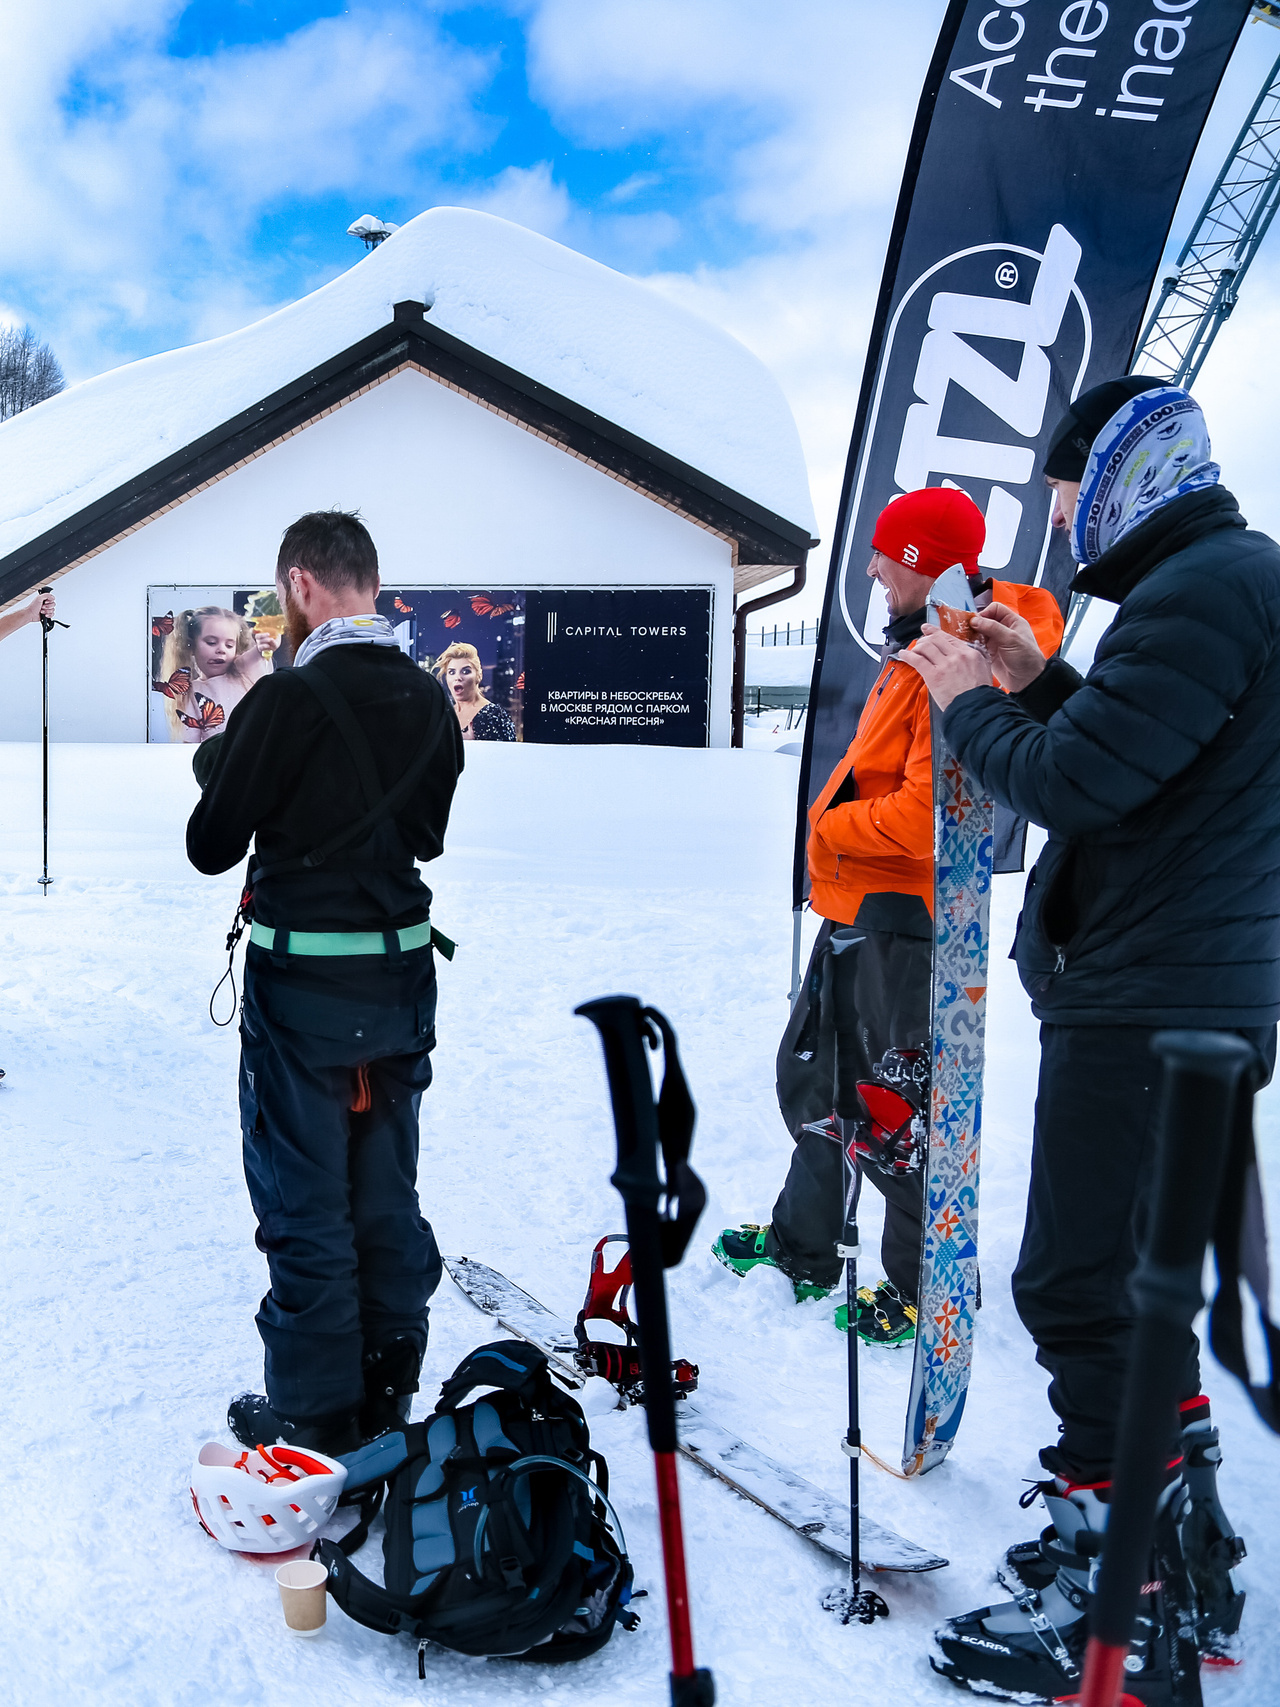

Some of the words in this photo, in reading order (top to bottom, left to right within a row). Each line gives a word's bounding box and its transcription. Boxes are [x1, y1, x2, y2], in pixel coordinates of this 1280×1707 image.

[948, 0, 1032, 110] Ac
[1023, 0, 1110, 113] the
[1141, 405, 1174, 430] 100
[1106, 451, 1124, 476] 50
[1088, 503, 1101, 526] 30
[565, 626, 622, 636] CAPITAL
[630, 626, 687, 636] TOWERS
[548, 691, 599, 700] КВАРТИРЫ
[601, 691, 608, 700] В
[610, 691, 684, 701] НЕБОСКРЕБАХ
[540, 703, 547, 713] В
[549, 703, 593, 713] МОСКВЕ
[595, 704, 633, 715] РЯДОМ
[635, 704, 644, 714] С
[646, 704, 690, 714] ПАРКОМ
[565, 716, 617, 726] «КРАСНАЯ
[619, 716, 665, 726] ПРЕСНЯ»
[960, 1635, 1012, 1655] SCARPA
